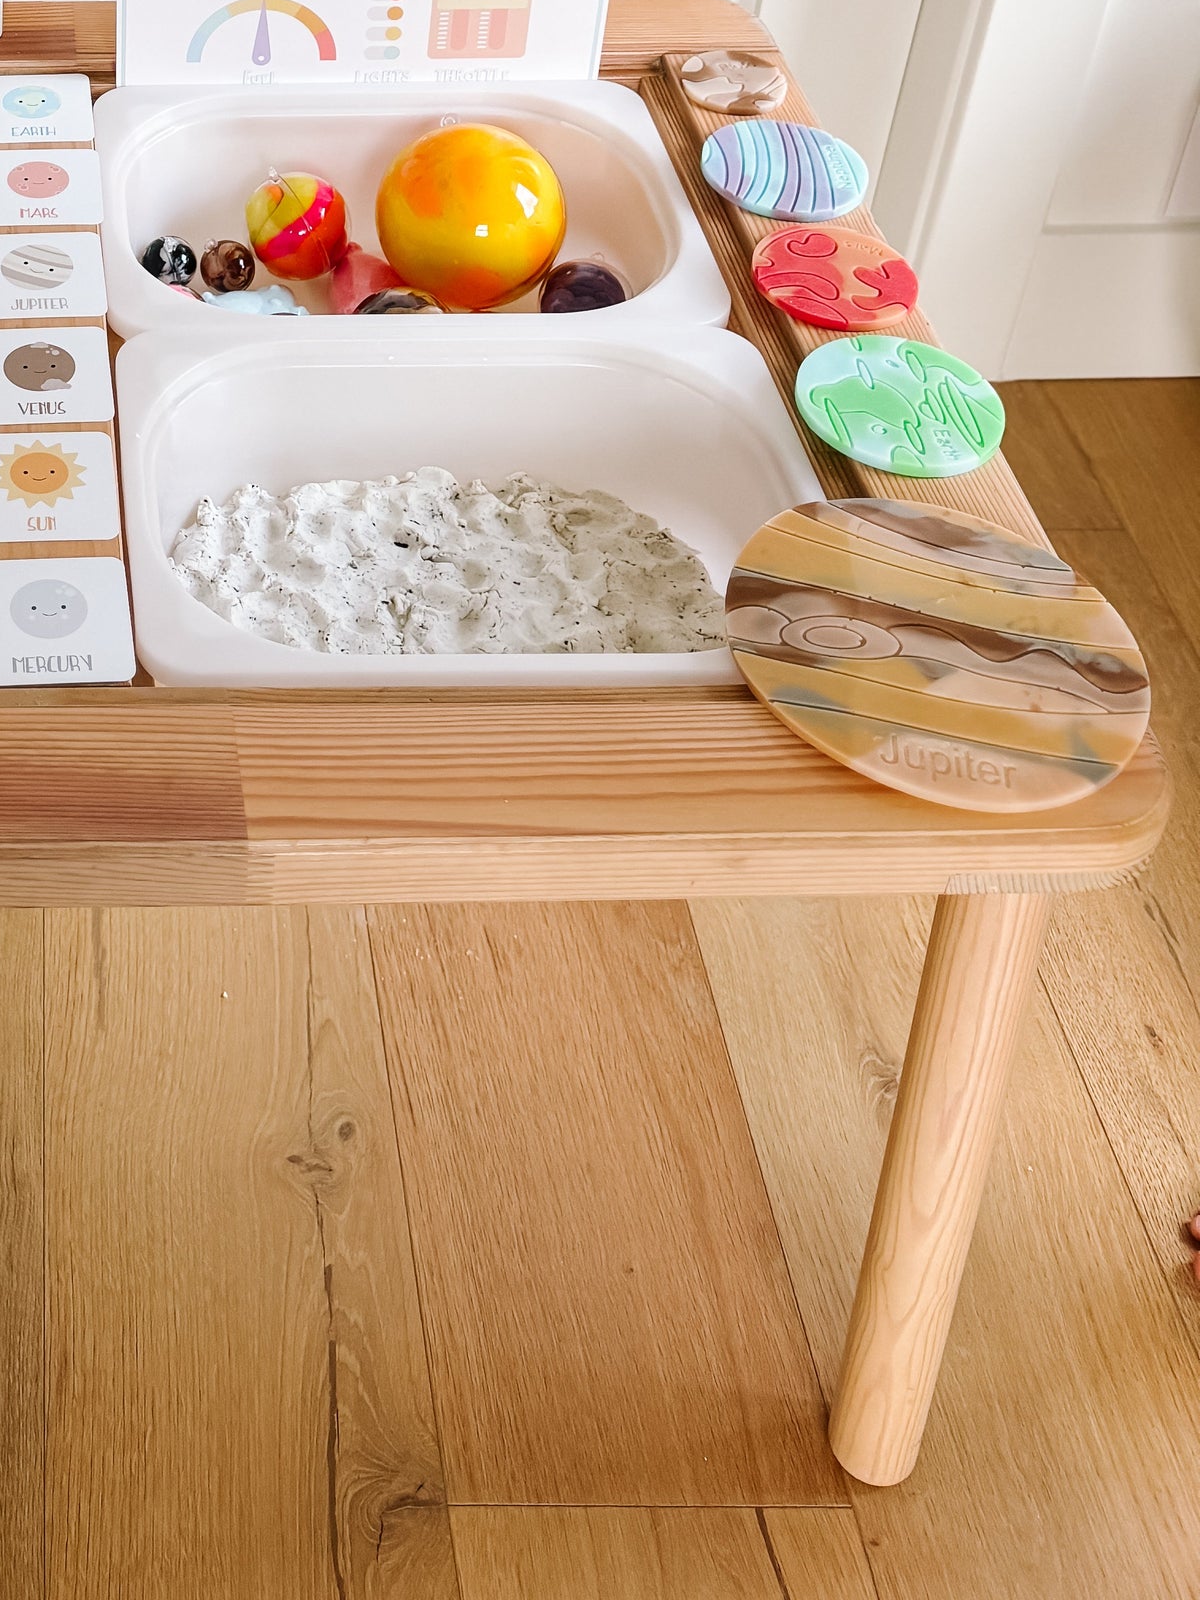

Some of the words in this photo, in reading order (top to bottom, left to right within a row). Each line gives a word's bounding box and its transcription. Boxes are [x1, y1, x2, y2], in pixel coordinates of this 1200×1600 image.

[11, 125, 57, 138] EARTH
[19, 207, 59, 220] MARS
[11, 298, 70, 311] JUPITER
[18, 401, 67, 416] VENUS
[26, 516, 57, 532] SUN
[12, 655, 94, 674] MERCURY
[879, 731, 1018, 790] Jupiter
